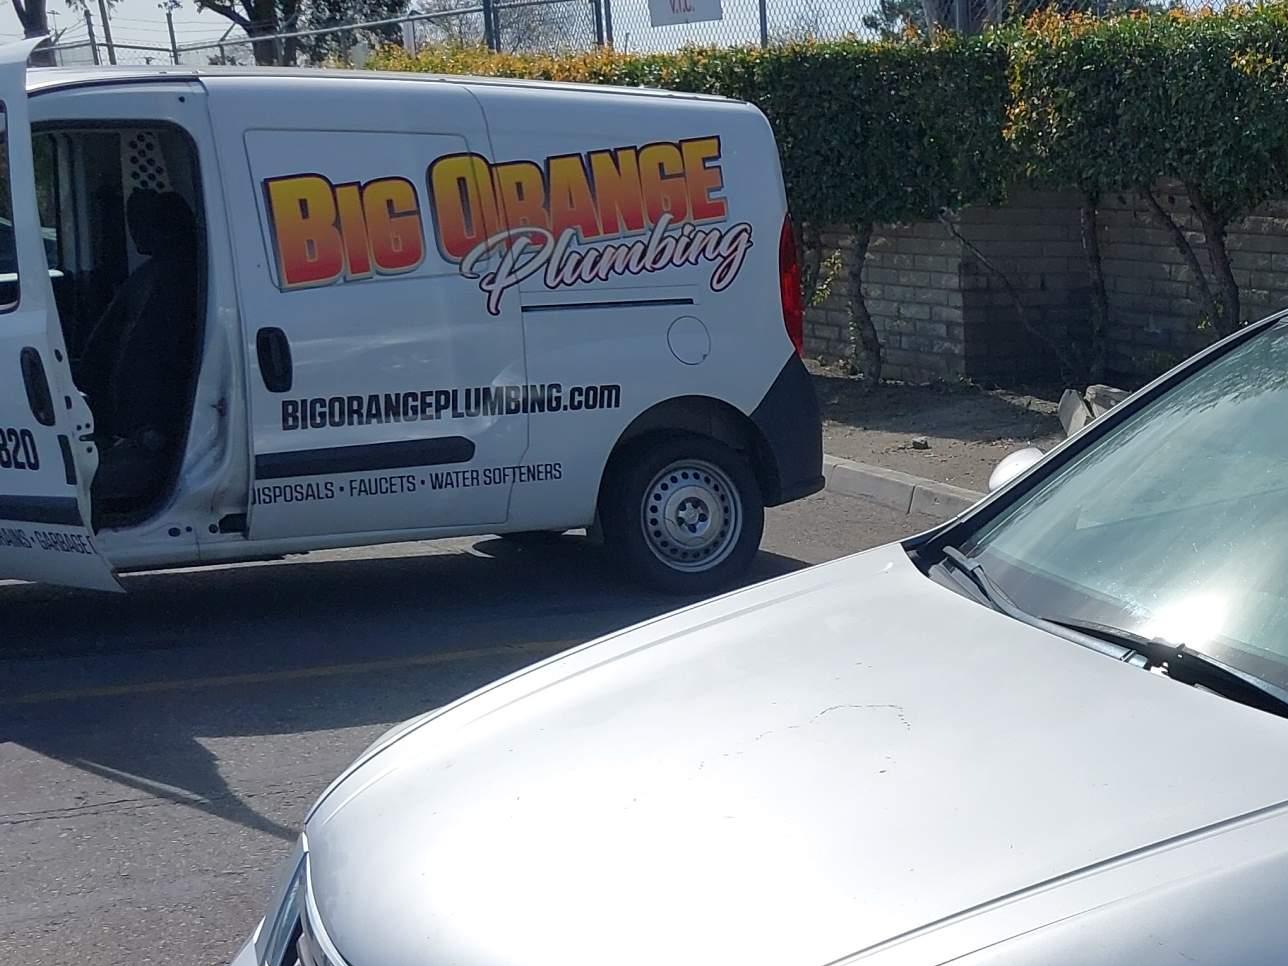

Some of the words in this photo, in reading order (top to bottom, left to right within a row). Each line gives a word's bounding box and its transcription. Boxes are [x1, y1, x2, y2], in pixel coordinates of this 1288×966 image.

[261, 173, 425, 293] BIG
[426, 136, 728, 267] ORANGE
[459, 213, 753, 316] Plumbing
[281, 383, 621, 431] BIGORANGEPLUMBING.com
[349, 475, 417, 497] FAUCETS
[430, 469, 480, 490] WATER
[483, 463, 562, 486] SOFTENERS
